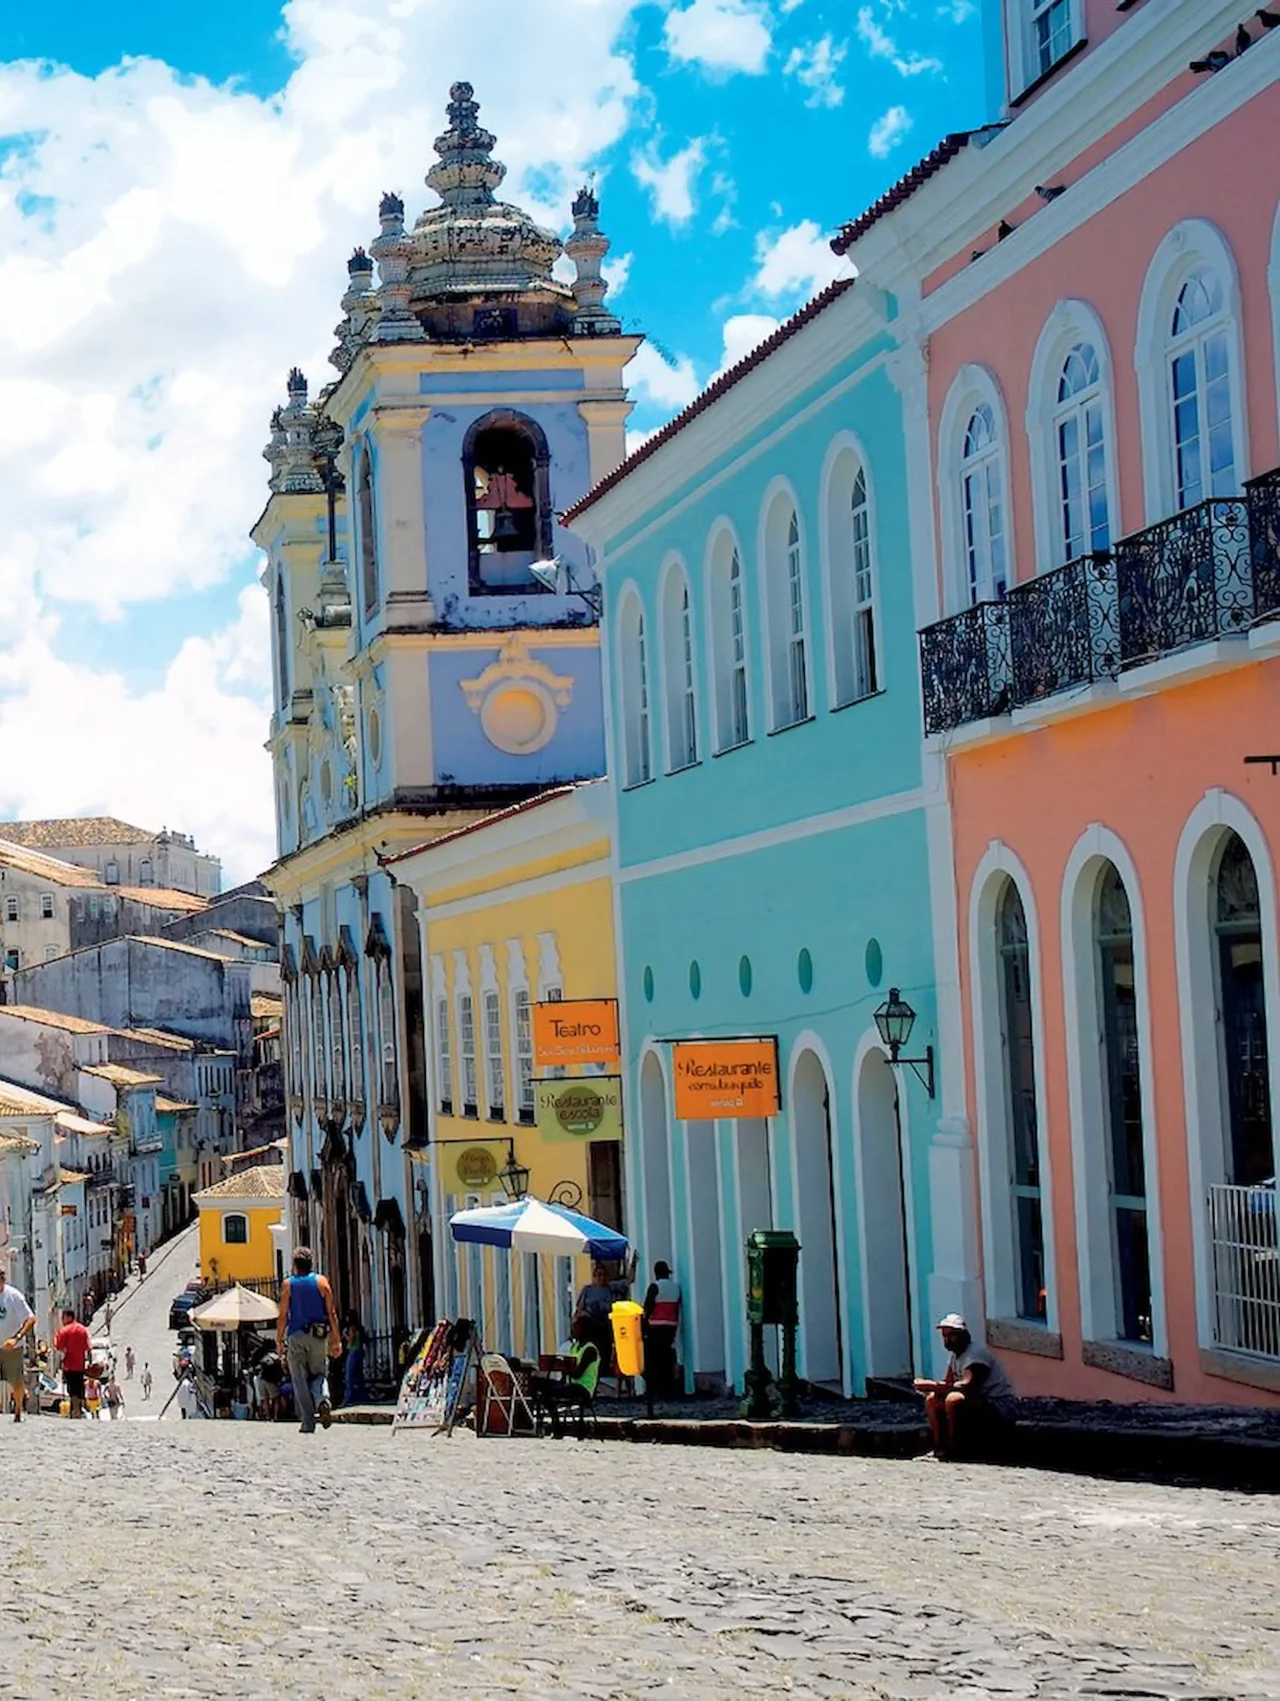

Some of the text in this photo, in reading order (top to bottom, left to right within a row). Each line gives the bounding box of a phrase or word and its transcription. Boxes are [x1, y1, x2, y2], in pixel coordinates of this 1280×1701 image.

[549, 1019, 602, 1038] Teatro
[677, 1059, 772, 1078] Restaurante
[540, 1092, 618, 1109] Restaurante
[559, 1106, 600, 1120] escola
